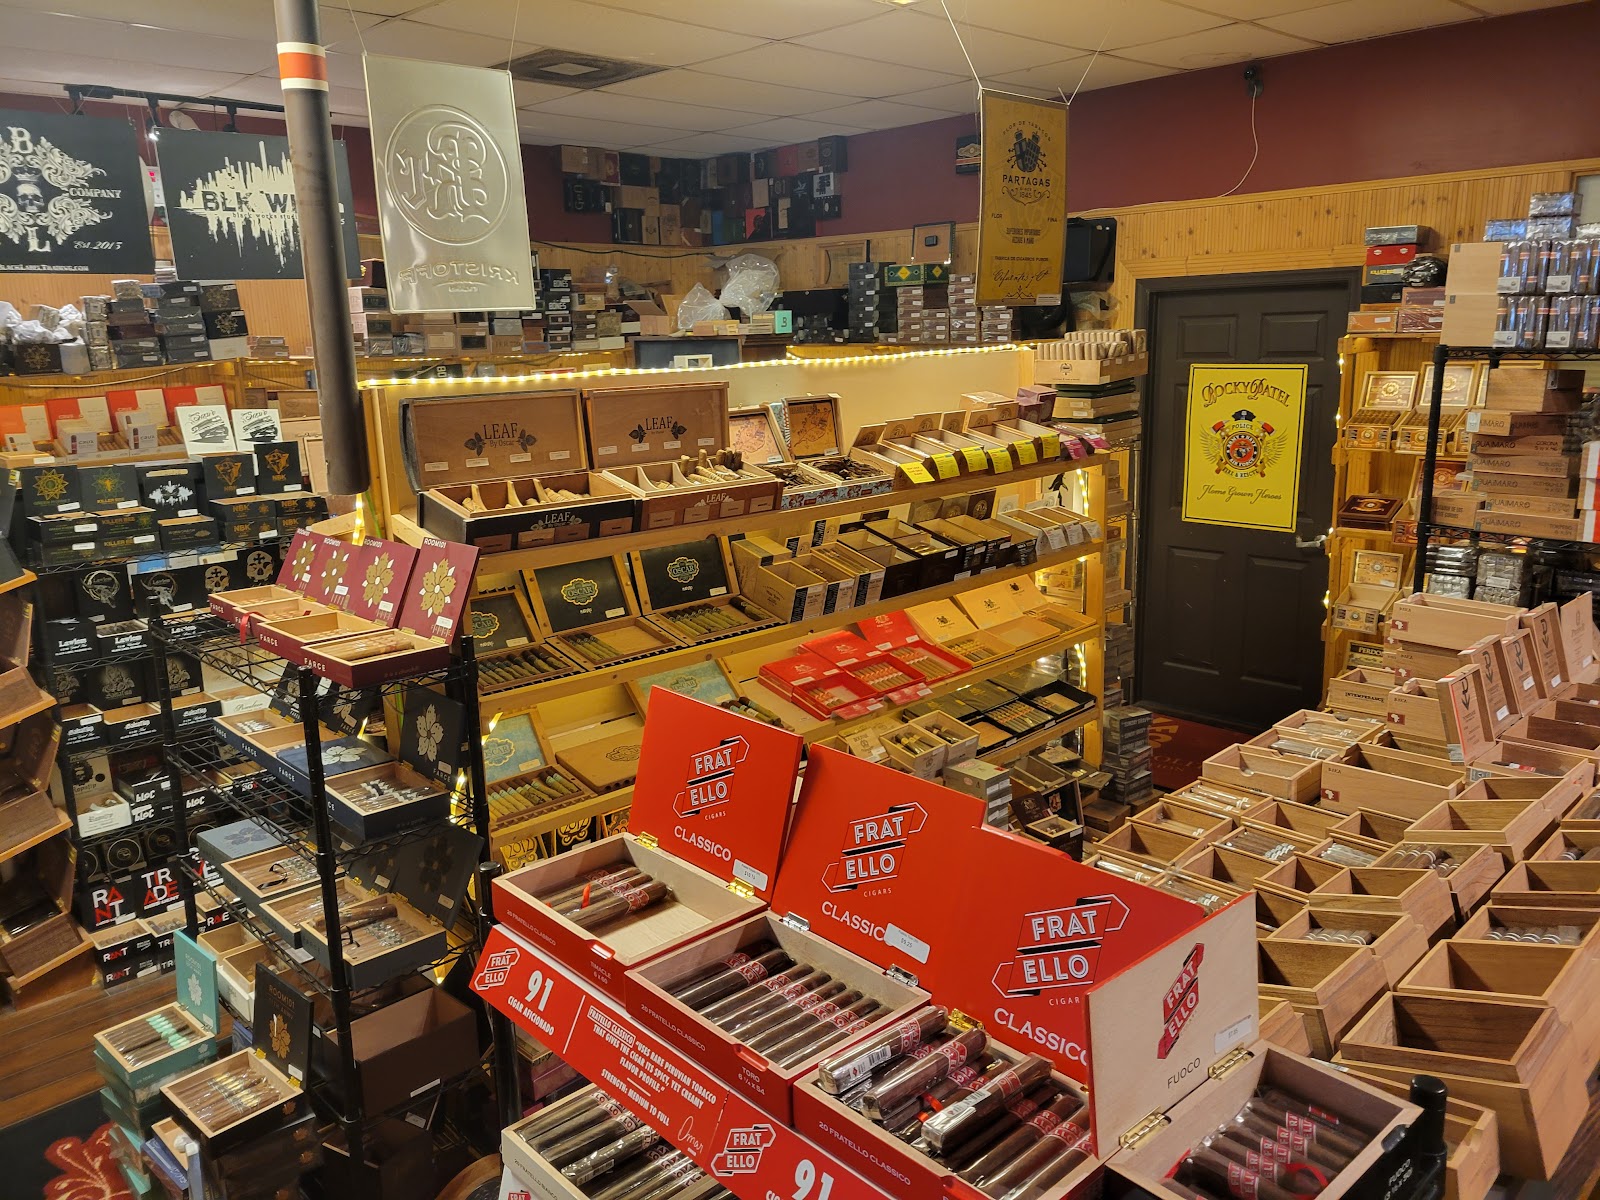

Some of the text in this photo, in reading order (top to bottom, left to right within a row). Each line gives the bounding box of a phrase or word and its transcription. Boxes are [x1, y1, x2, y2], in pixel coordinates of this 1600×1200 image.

[1002, 174, 1051, 188] PARTAGAS
[68, 187, 122, 199] COMPANY
[1019, 190, 1033, 200] 1845
[201, 189, 256, 213] BLK
[1201, 378, 1291, 408] ROCKY PATEL
[482, 422, 519, 440] LEAF
[645, 416, 674, 432] LEAF
[1231, 423, 1254, 431] POLICE
[489, 439, 515, 449] By Oscar
[1476, 440, 1516, 449] GUAIMARO
[1472, 458, 1511, 468] GUAIMARO
[271, 474, 286, 482] NBK
[706, 492, 727, 504] LEAF
[1197, 485, 1282, 505] Home Grown Heroes
[232, 504, 251, 513] NBK
[281, 499, 299, 508] NBK
[1490, 499, 1530, 509] GUAIMARO
[282, 517, 299, 527] NBK
[544, 511, 571, 525] LEAF
[1480, 517, 1521, 529] GUAIMARO
[233, 523, 251, 532] NBK
[104, 540, 125, 548] KILLER
[324, 537, 342, 547] ROOM101
[364, 538, 383, 549] ROOM101
[424, 537, 447, 549] ROOM101
[672, 564, 696, 575] OSCAR
[567, 586, 596, 598] OSCAR
[209, 602, 225, 614] FARCE
[472, 618, 493, 629] SCAR
[259, 633, 278, 648] FARCE
[304, 657, 327, 672] FARCE
[289, 710, 301, 720] FARCE
[214, 726, 227, 739] FARCE
[241, 743, 258, 758] FARCE
[694, 747, 732, 776] FRAT
[278, 767, 296, 782] FARCE
[433, 767, 452, 783] FARCE
[689, 781, 728, 806] ELLO
[704, 811, 727, 821] CIGARS
[853, 816, 905, 845] FRAT
[674, 825, 732, 862] CLASSICO
[845, 853, 896, 881] ELLO
[862, 887, 893, 898] CIGARS
[207, 911, 231, 926] RAVE
[821, 901, 888, 943] CLASSIC
[1030, 910, 1099, 942] FRAT
[513, 912, 535, 932] FRATELLO
[533, 927, 557, 947] CLASSICO
[103, 947, 128, 963] RANT
[490, 954, 512, 967] FRAT
[106, 966, 131, 983] RANT
[484, 970, 506, 984] ELLO
[590, 961, 612, 978] TIMACLE
[1022, 954, 1089, 985] ELLO
[601, 976, 609, 985] 60
[1166, 961, 1197, 1010] FRAT
[268, 985, 296, 1010] ROOM101
[524, 969, 555, 1012] 91
[1048, 996, 1081, 1007] CIGAR
[507, 995, 555, 1036] CIGAR AFICIONADO
[1167, 992, 1197, 1039] ELLO
[640, 1003, 707, 1052] 20 FRATELLO CLASSICO
[590, 1008, 612, 1029] FRATELLO
[611, 1022, 634, 1046] CLASSICO
[650, 1049, 665, 1067] RARE
[664, 1061, 691, 1088] PERUVIAN
[691, 1079, 717, 1105] TOBACCO
[593, 1024, 705, 1110] THAT GIVES THE CIGAR ITS SPICY, YET CREAMY
[619, 1056, 639, 1077] FLAVOR
[1166, 1057, 1202, 1090] FUOCO
[741, 1066, 760, 1083] TORO
[601, 1068, 671, 1127] STRENGTH: MEDIUM TO FULL
[677, 1115, 705, 1154] Omar
[732, 1132, 763, 1147] FRAT
[818, 1121, 912, 1186] 20 FRATELLO CLASSICO
[726, 1154, 756, 1169] ELLO
[792, 1159, 836, 1200] 91
[1389, 1158, 1411, 1187] FUOCO
